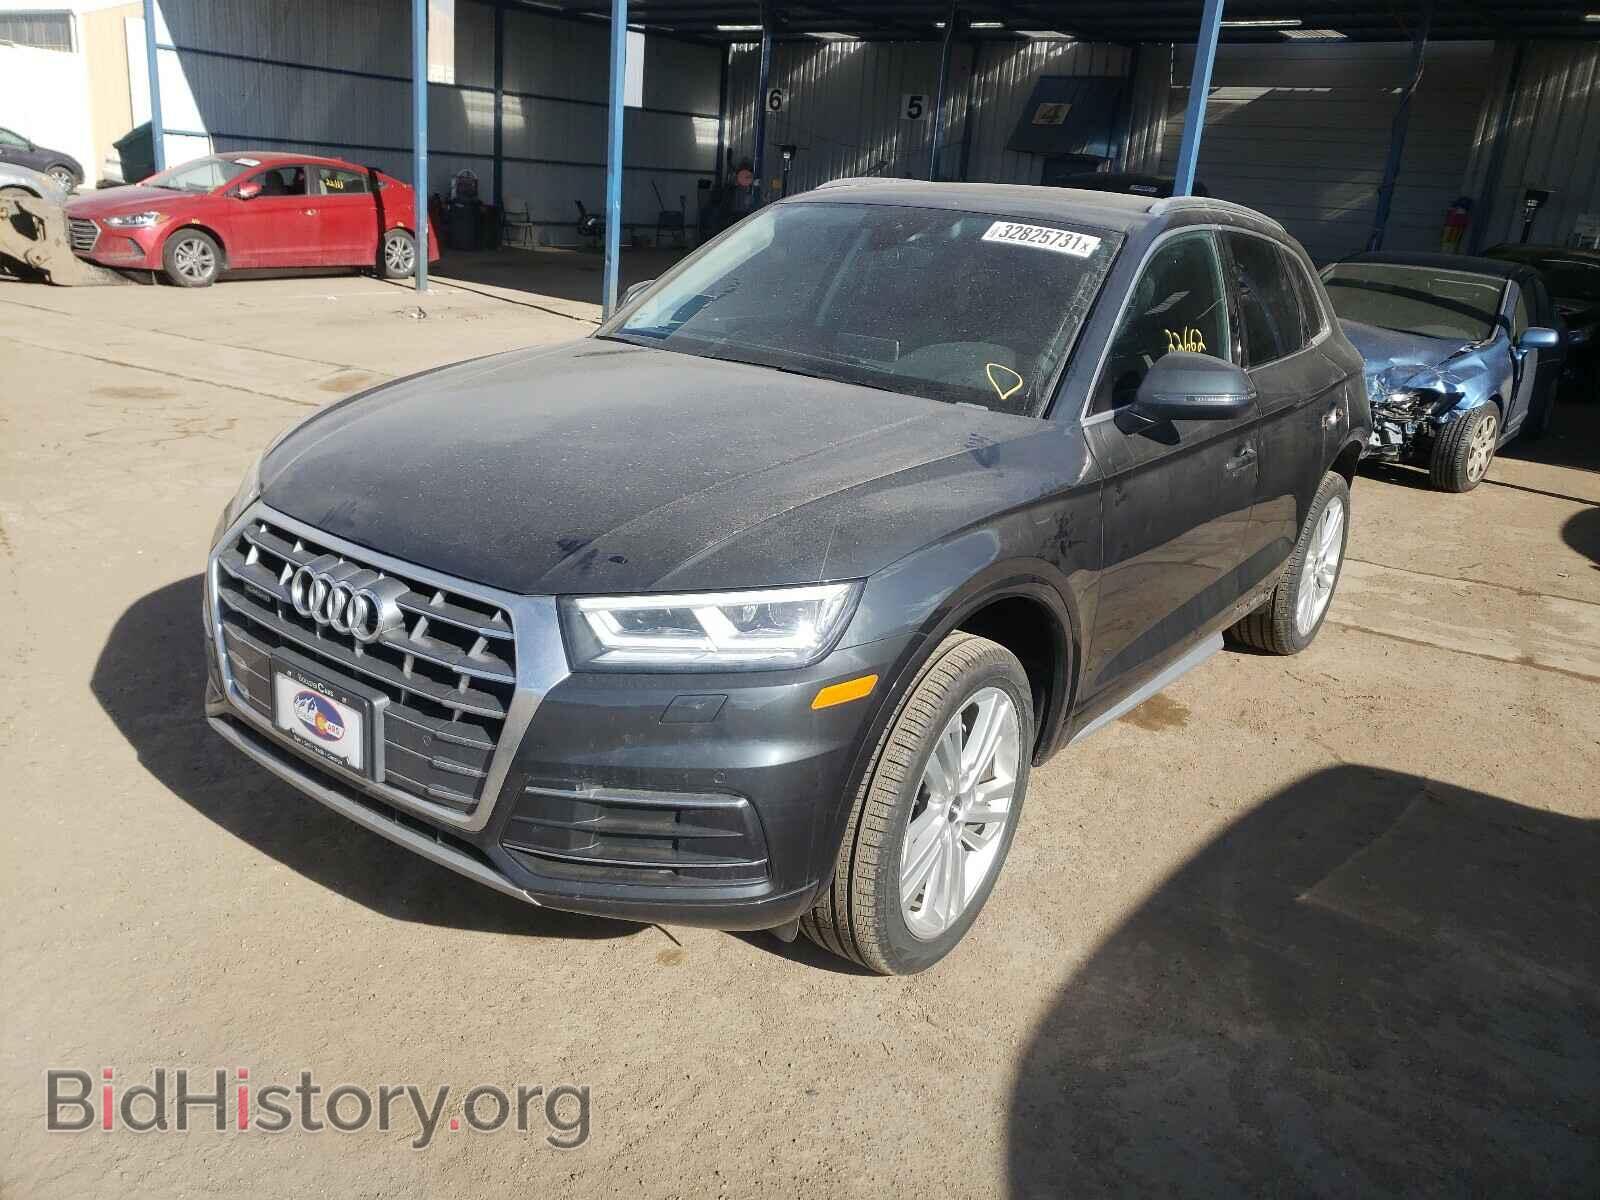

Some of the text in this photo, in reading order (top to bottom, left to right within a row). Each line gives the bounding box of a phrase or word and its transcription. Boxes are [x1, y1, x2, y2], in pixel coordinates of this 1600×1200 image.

[768, 89, 782, 111] 6
[907, 96, 922, 119] 5
[999, 224, 1082, 250] 32825731
